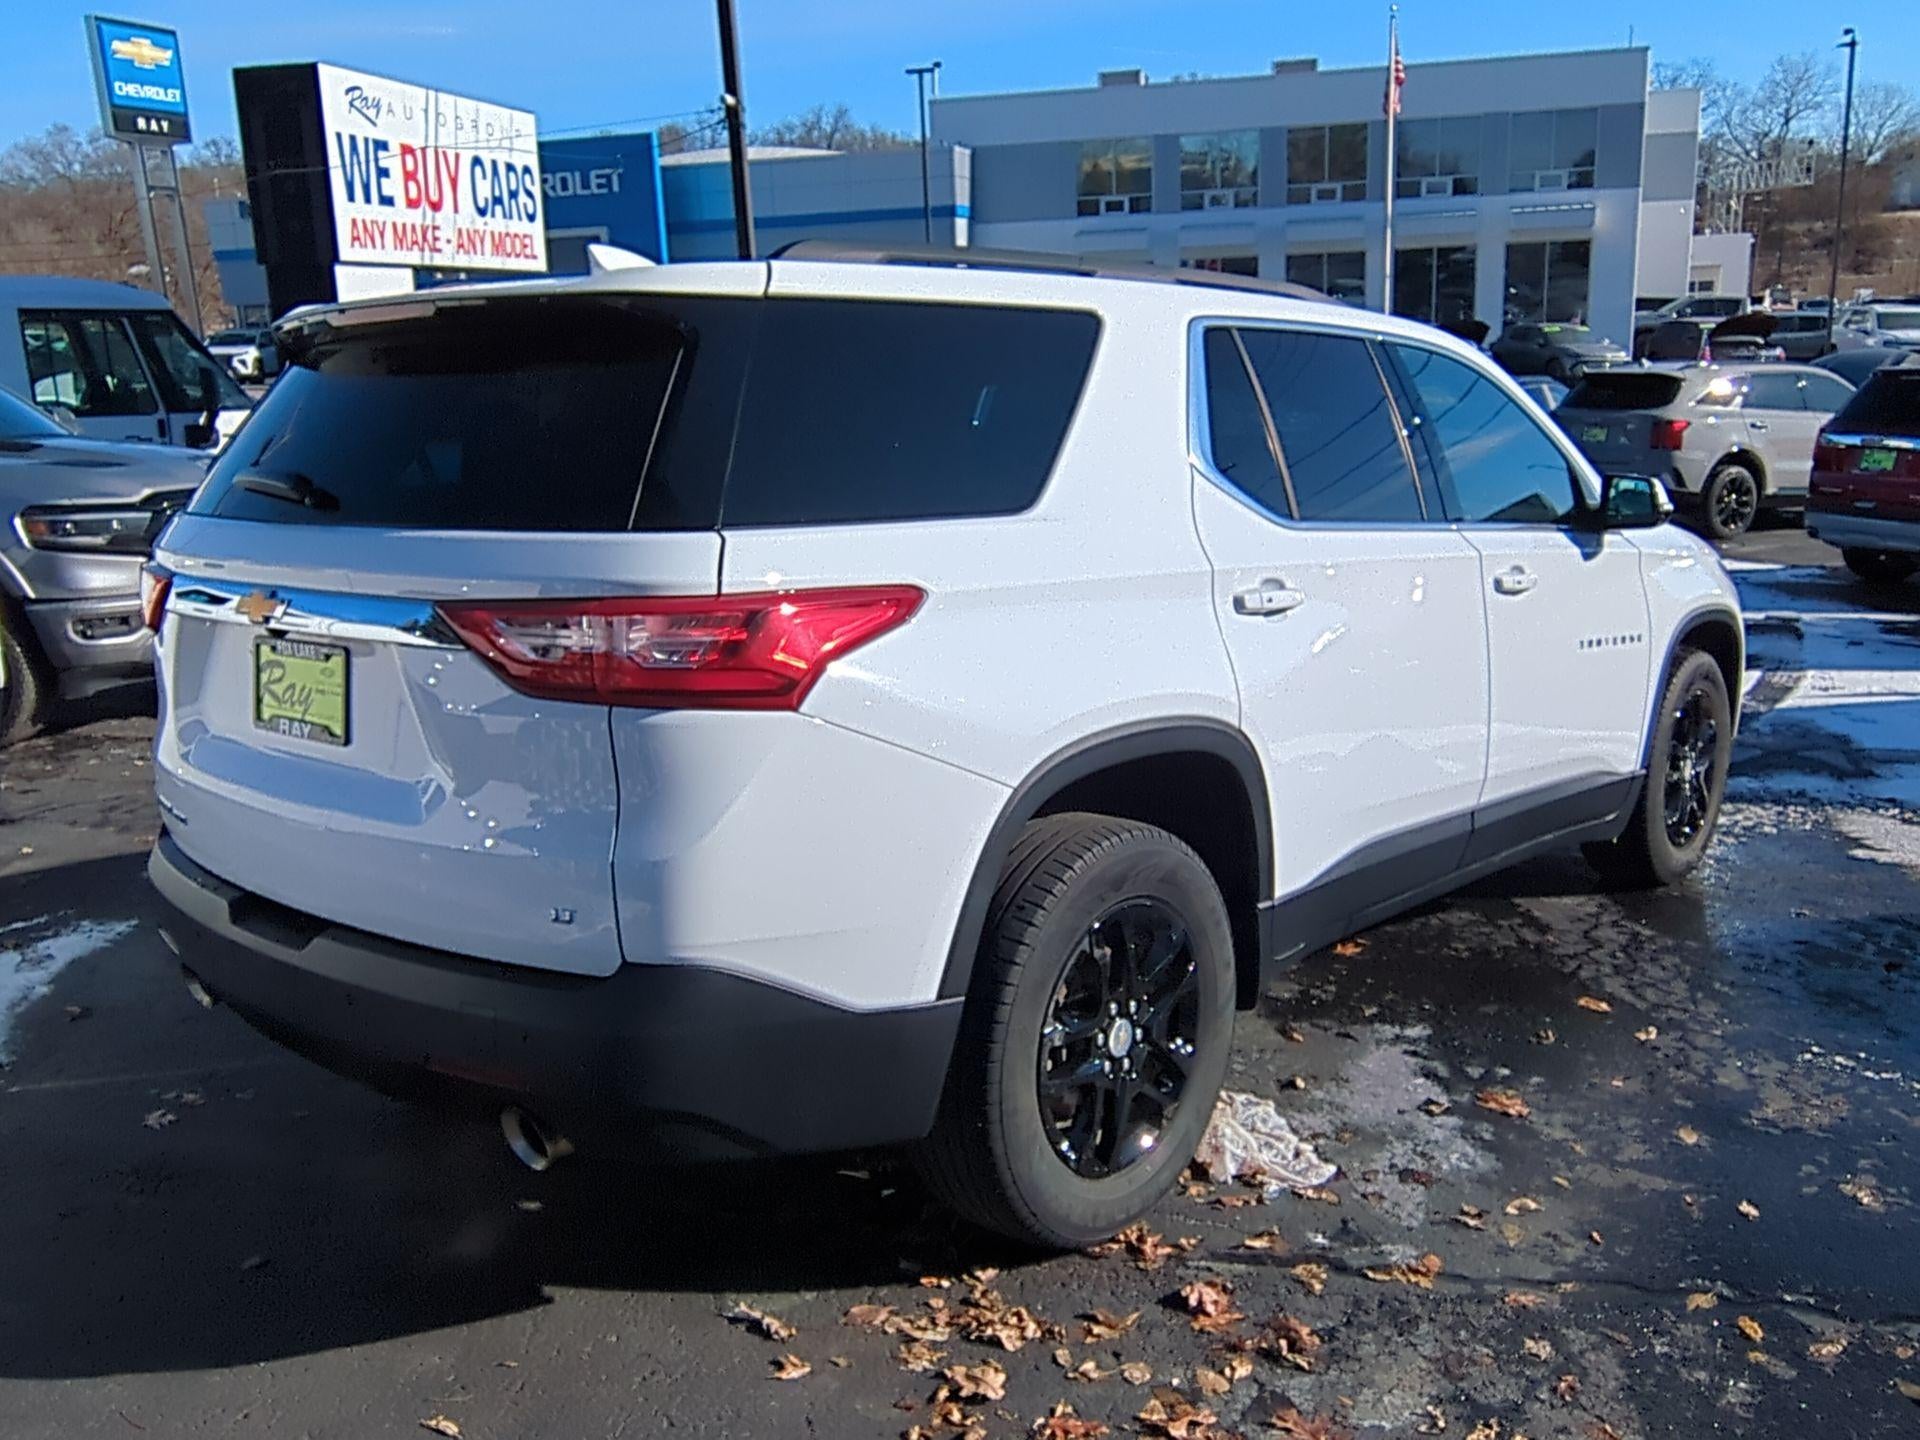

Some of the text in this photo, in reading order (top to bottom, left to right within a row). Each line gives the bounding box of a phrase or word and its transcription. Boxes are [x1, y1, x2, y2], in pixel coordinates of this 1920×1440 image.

[113, 81, 180, 103] CHEVROLET
[344, 86, 382, 128] Ray
[136, 116, 169, 133] RAY
[335, 131, 537, 223] WE BUY CARS
[350, 217, 387, 250] ANY
[392, 221, 442, 253] MAKE
[456, 227, 487, 256] ANY
[490, 230, 538, 259] MODEL
[260, 660, 314, 719] Ray
[279, 718, 312, 739] RAY
